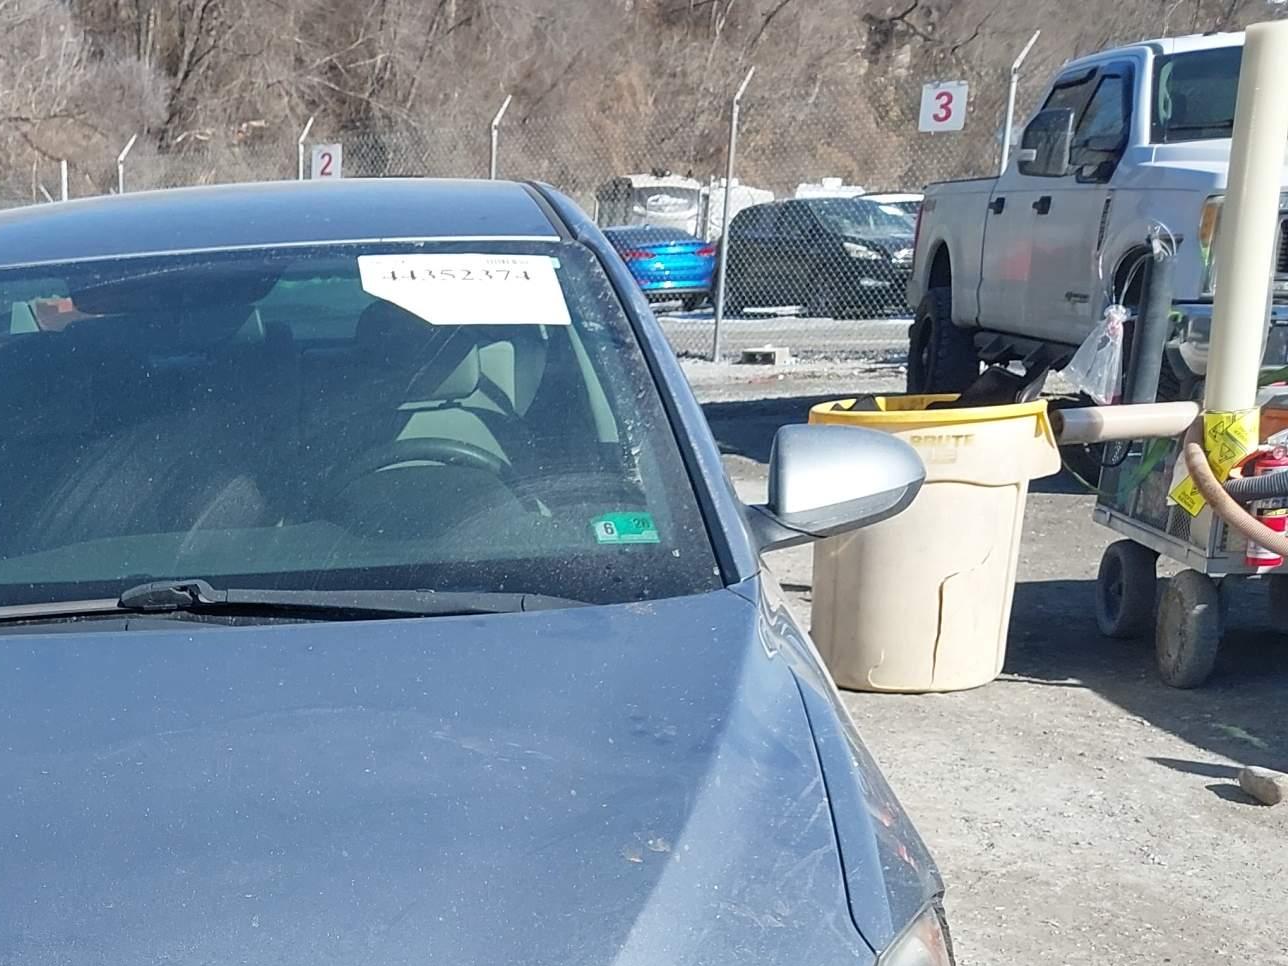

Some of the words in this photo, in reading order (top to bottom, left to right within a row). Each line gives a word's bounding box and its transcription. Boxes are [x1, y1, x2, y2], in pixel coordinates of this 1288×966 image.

[932, 90, 954, 123] 3
[320, 152, 333, 176] 2
[381, 268, 531, 281] 44352374
[603, 522, 615, 535] 6
